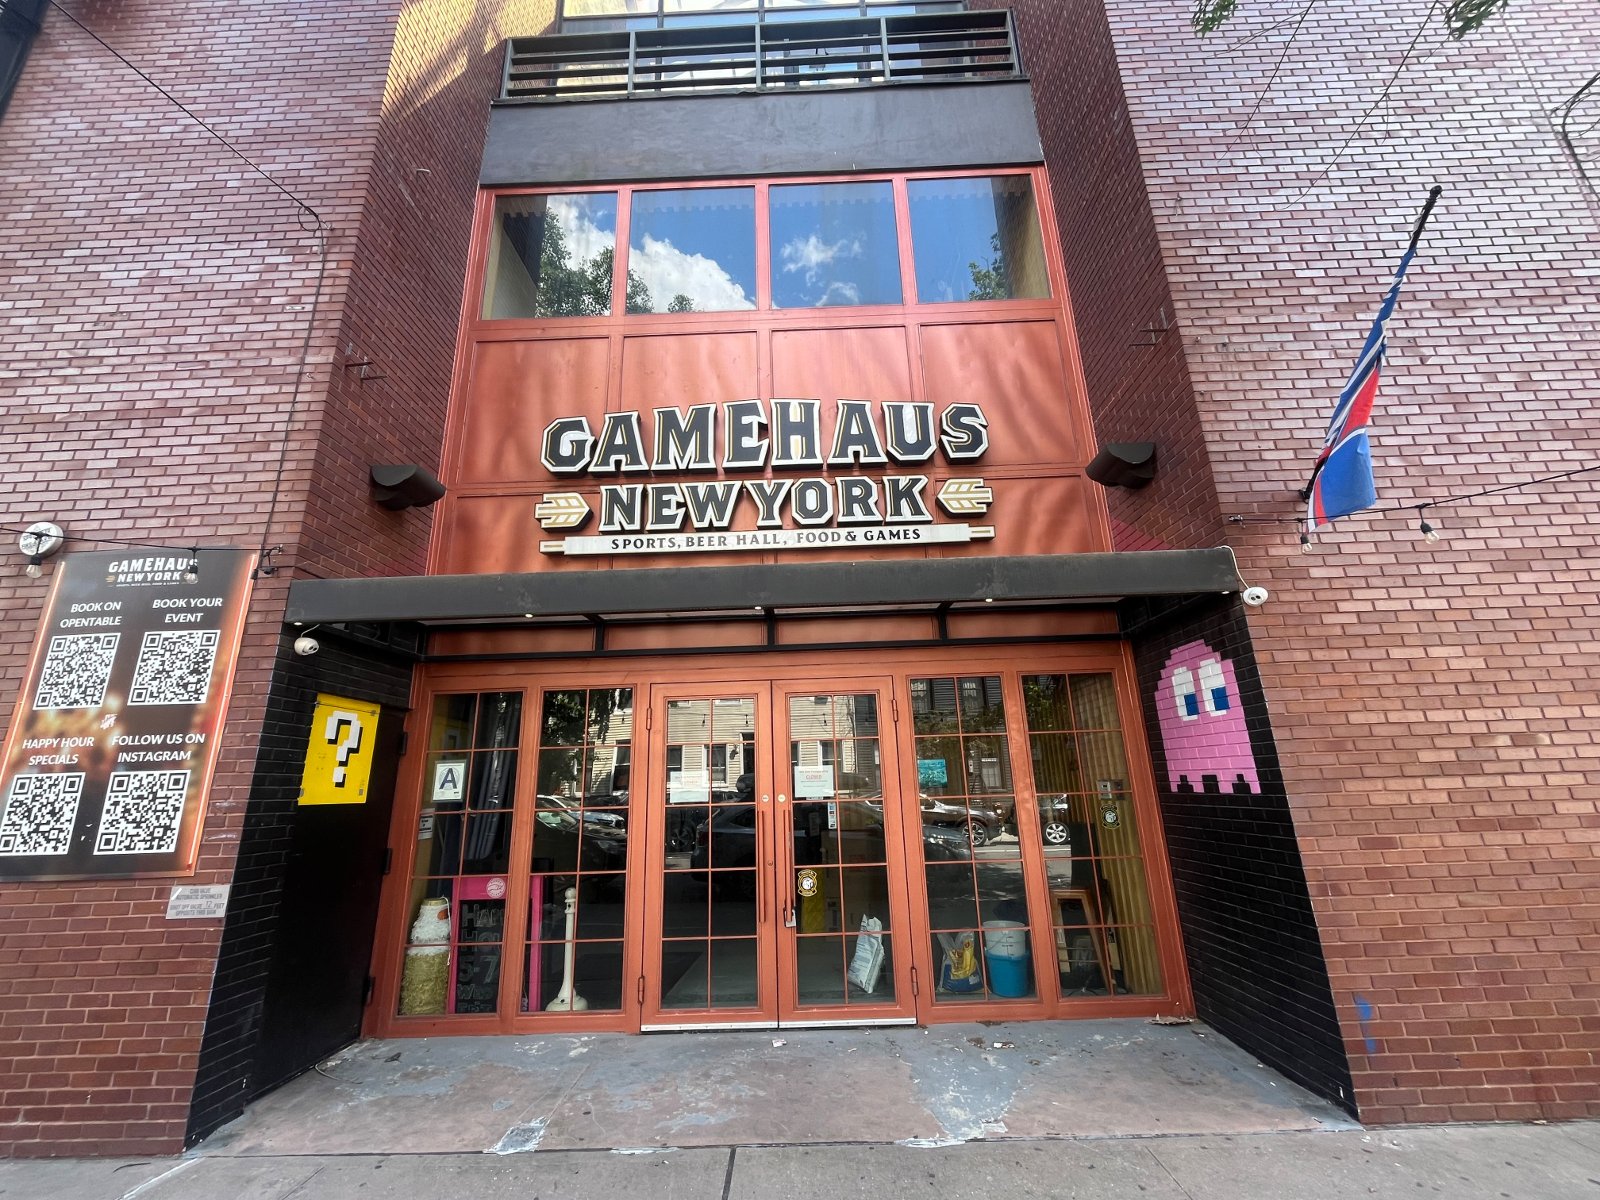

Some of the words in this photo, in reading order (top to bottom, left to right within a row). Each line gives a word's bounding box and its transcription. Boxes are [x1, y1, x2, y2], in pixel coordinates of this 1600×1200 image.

[540, 398, 990, 475] GAMEHAUS
[611, 535, 681, 550] SPORTS,
[685, 534, 727, 547] BEER
[736, 532, 787, 547] HALL,
[796, 531, 842, 544] FOOD
[844, 530, 857, 542] &
[863, 528, 921, 542] GAMES
[71, 602, 102, 613] BOOK
[103, 601, 122, 612] ON
[152, 599, 188, 609] BOOK
[190, 597, 223, 607] YOUR
[60, 616, 122, 629] OPENTABLE
[164, 613, 204, 623] EVENT
[22, 737, 61, 749] HAPPY
[61, 736, 95, 748] HOUR
[111, 735, 165, 746] FOLLOW
[166, 734, 184, 745] US
[185, 733, 206, 744] ON
[28, 754, 79, 766] SPECIALS
[117, 750, 192, 763] INSTAGRAM
[439, 767, 458, 790] A
